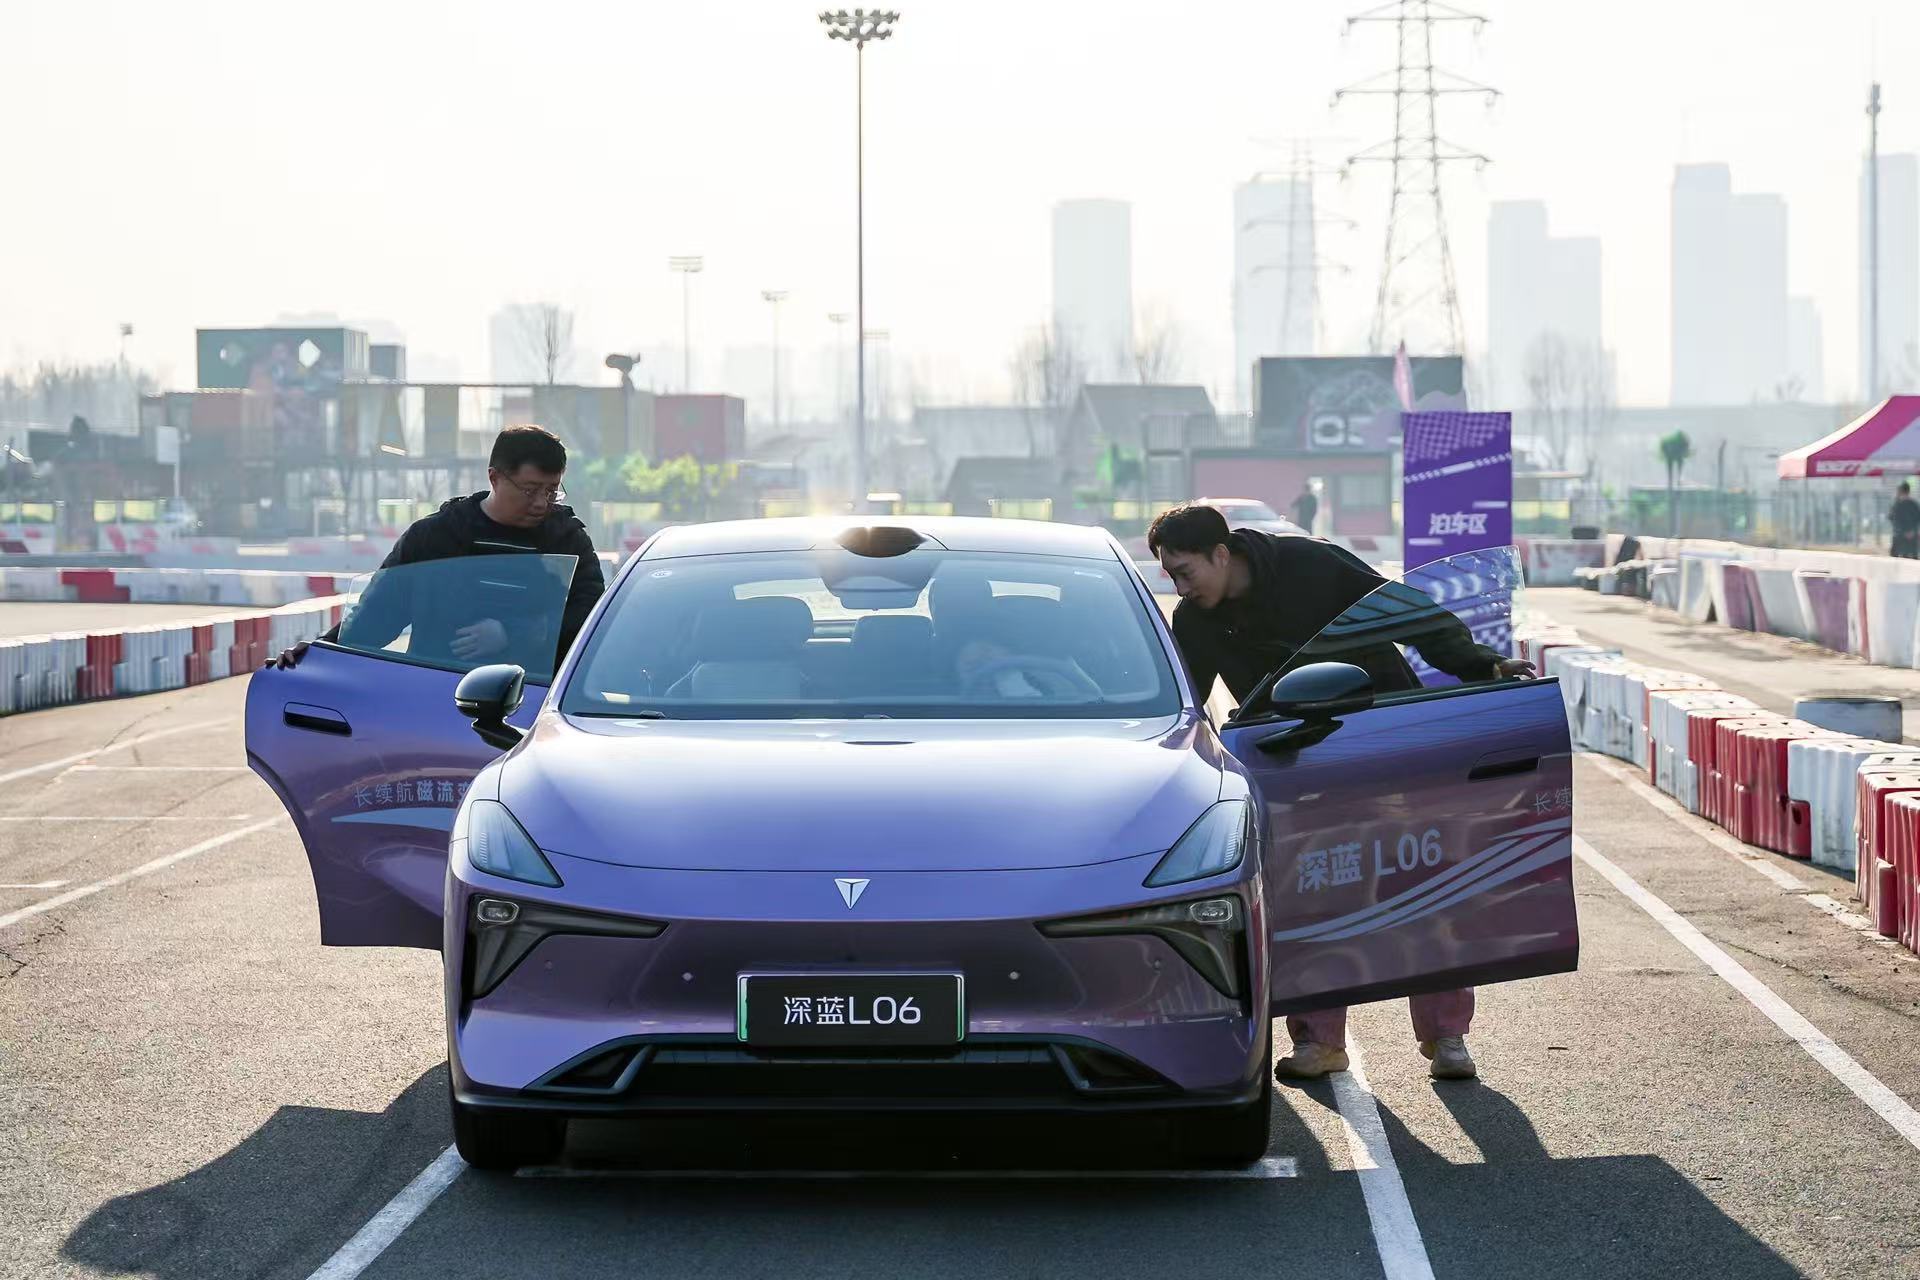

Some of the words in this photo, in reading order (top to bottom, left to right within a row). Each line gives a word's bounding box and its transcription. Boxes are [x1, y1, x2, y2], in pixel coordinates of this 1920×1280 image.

[1429, 512, 1488, 536] 泊车区
[1297, 841, 1362, 893] 深蓝
[1374, 828, 1442, 876] L06
[783, 996, 921, 1025] 深蓝L06
